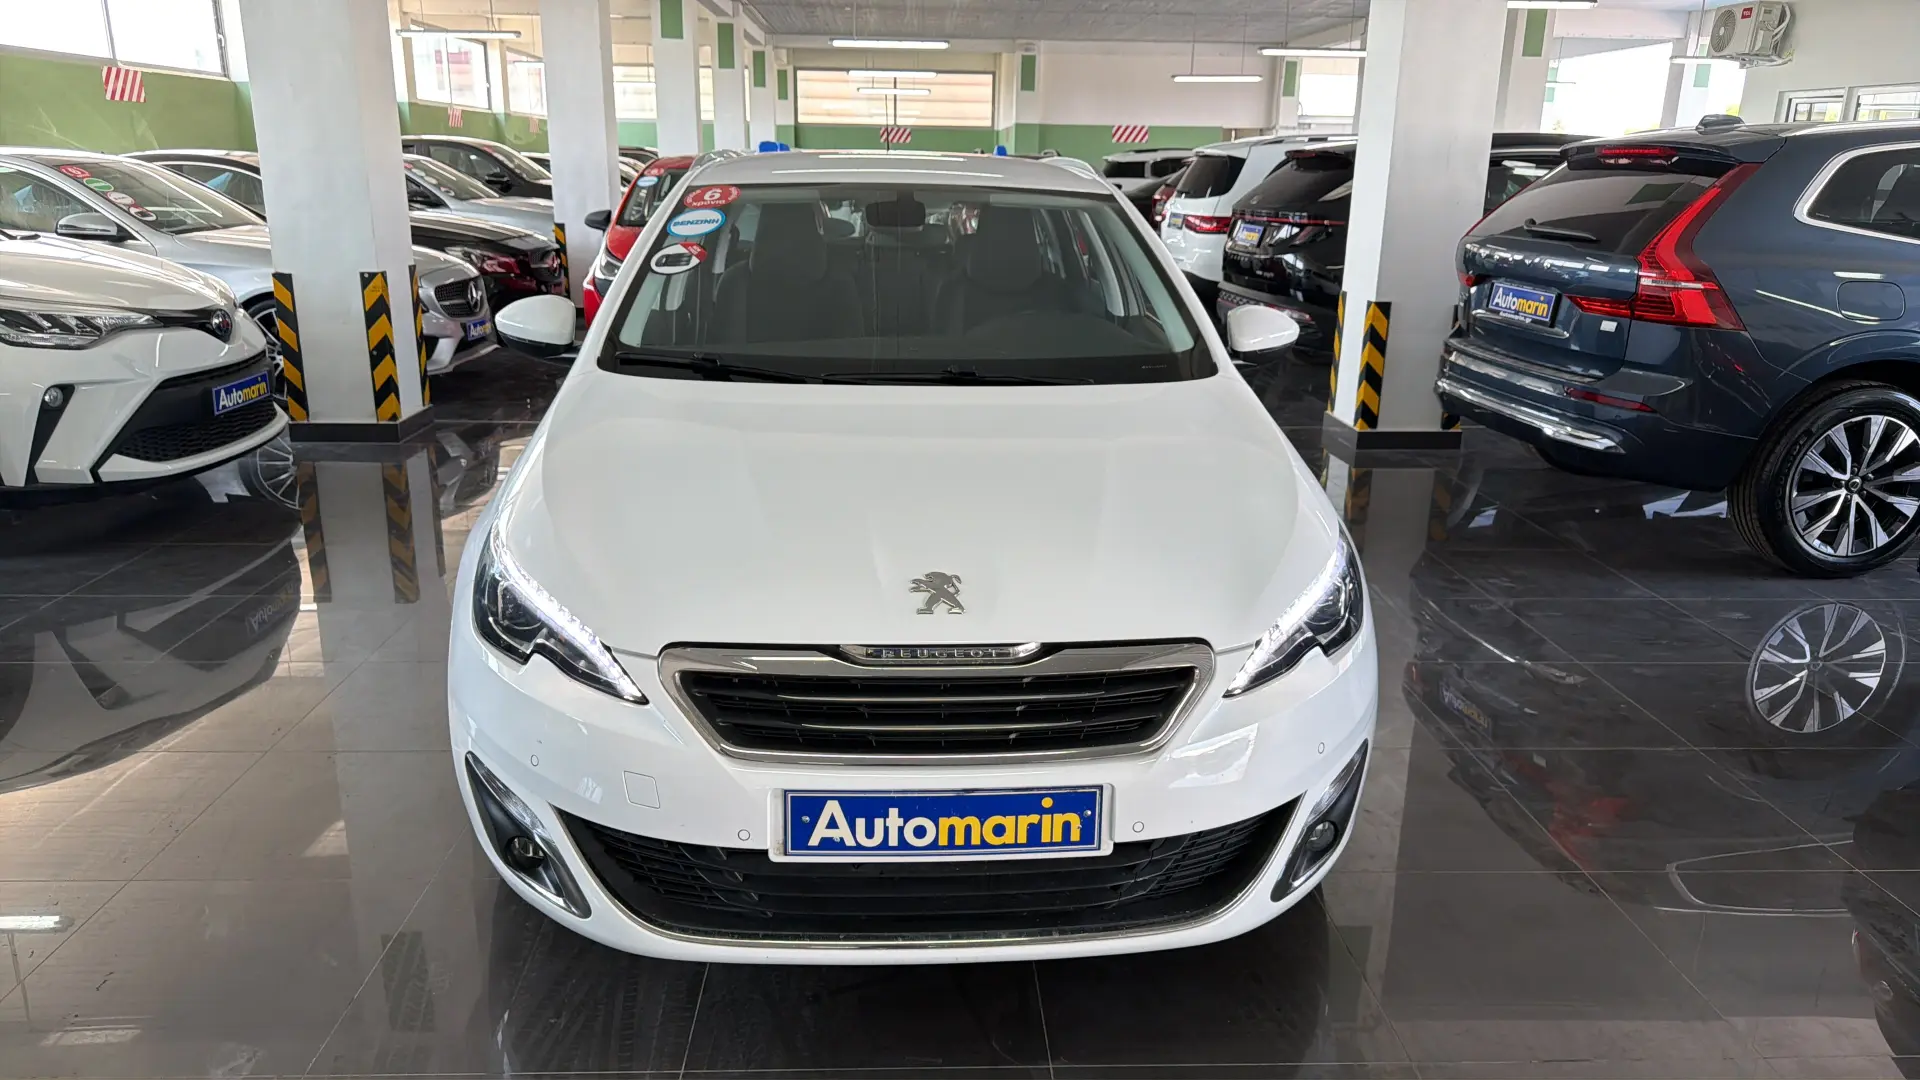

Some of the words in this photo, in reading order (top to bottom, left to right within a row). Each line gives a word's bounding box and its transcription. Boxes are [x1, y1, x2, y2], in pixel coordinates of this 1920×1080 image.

[704, 188, 722, 201] 6
[1493, 286, 1549, 318] Automarin
[218, 376, 268, 411] Automarin
[881, 648, 998, 659] PEUGEOT
[807, 797, 1082, 848] Automarin
